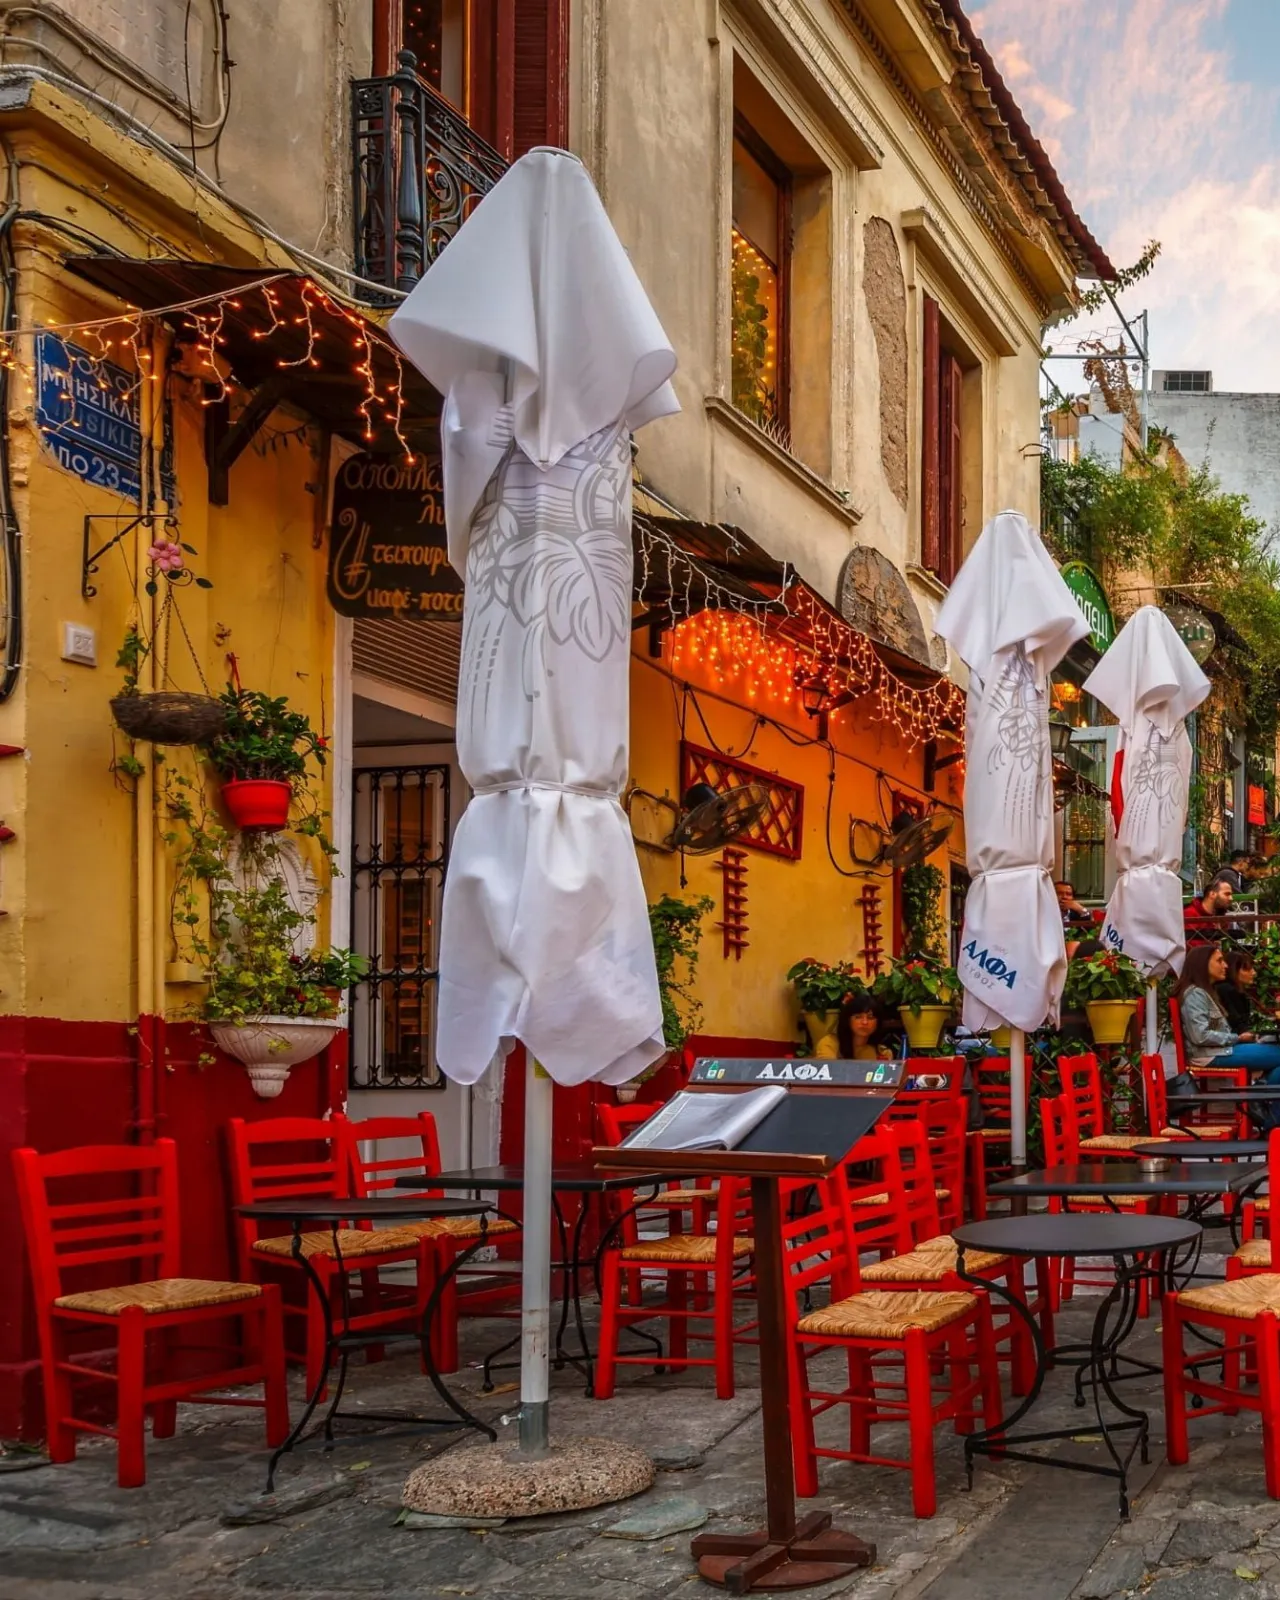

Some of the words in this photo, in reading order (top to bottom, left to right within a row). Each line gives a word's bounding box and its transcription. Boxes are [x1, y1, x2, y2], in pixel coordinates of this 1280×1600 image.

[76, 356, 131, 393] ΟΔΟ
[962, 939, 1018, 990] ΑΛΦΑ
[756, 1062, 833, 1081] ΑΛΦΑ
